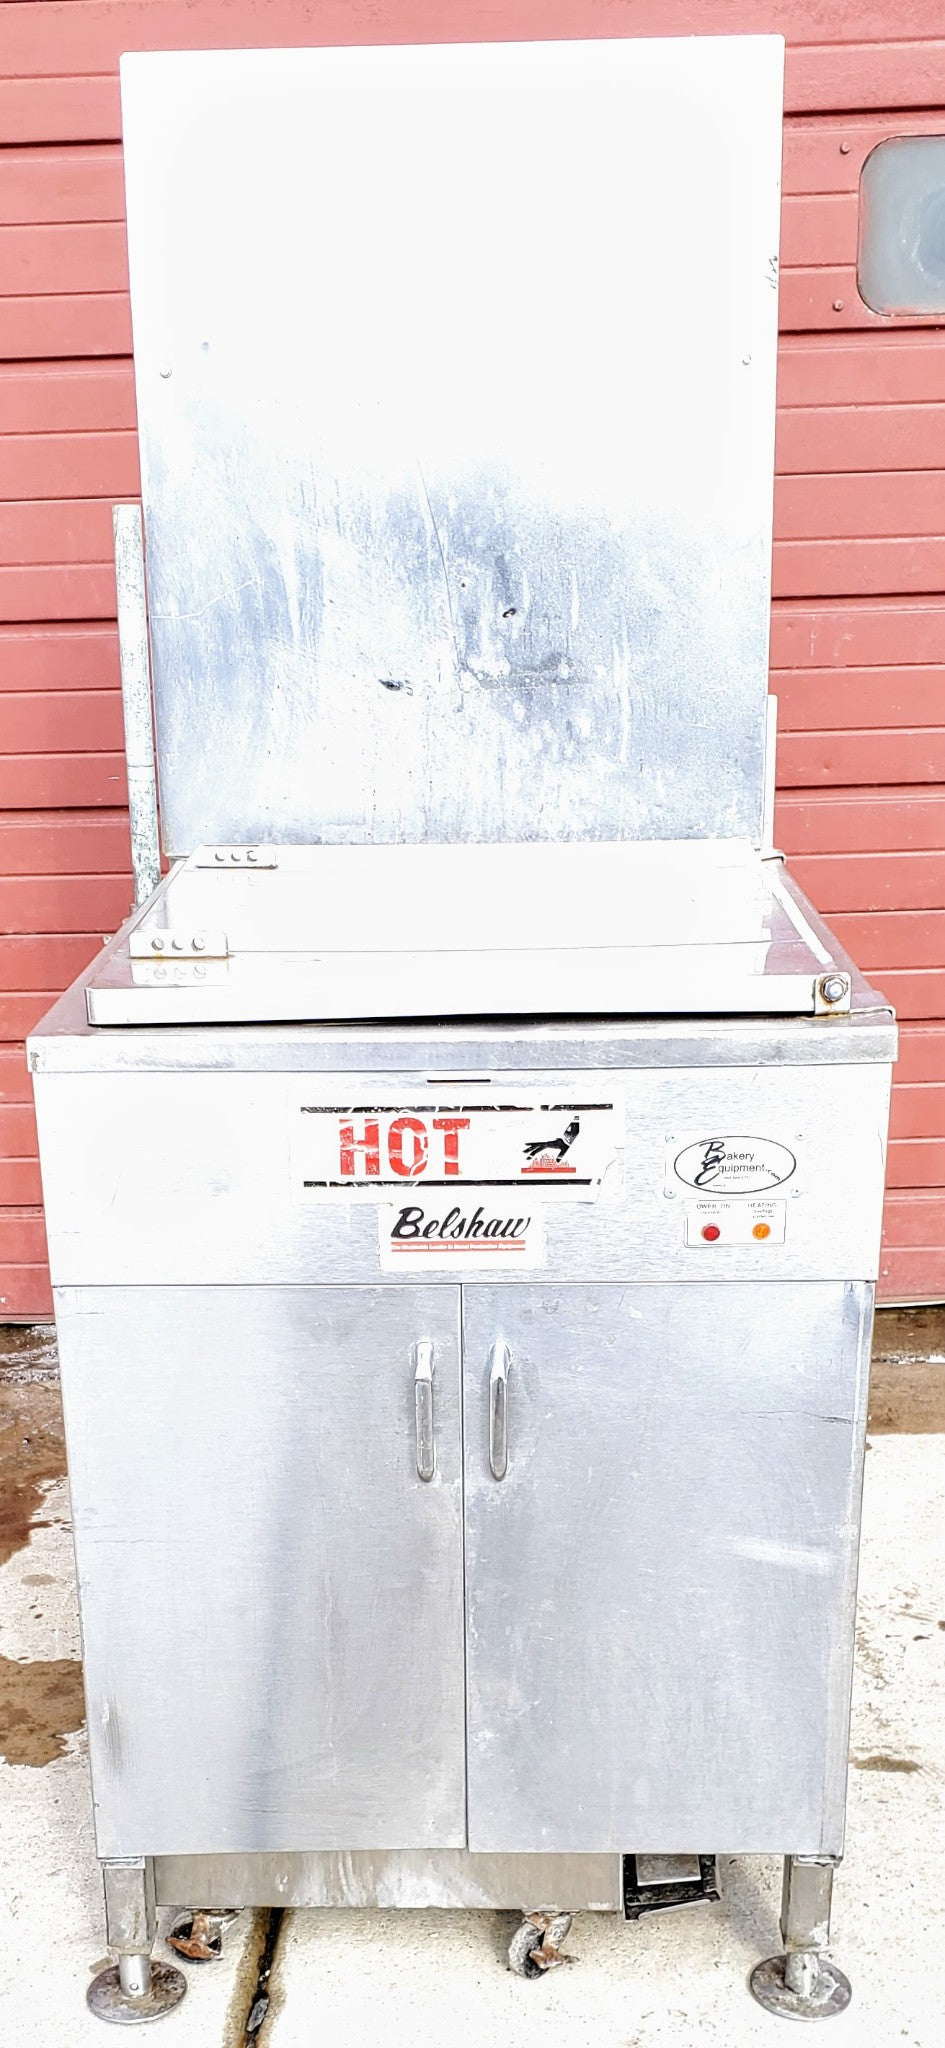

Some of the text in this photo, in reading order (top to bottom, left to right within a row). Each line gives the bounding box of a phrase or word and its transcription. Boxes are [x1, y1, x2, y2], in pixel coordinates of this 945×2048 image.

[339, 1117, 470, 1177] HOT
[698, 1141, 755, 1162] Bakery
[391, 1206, 531, 1239] Belshaw
